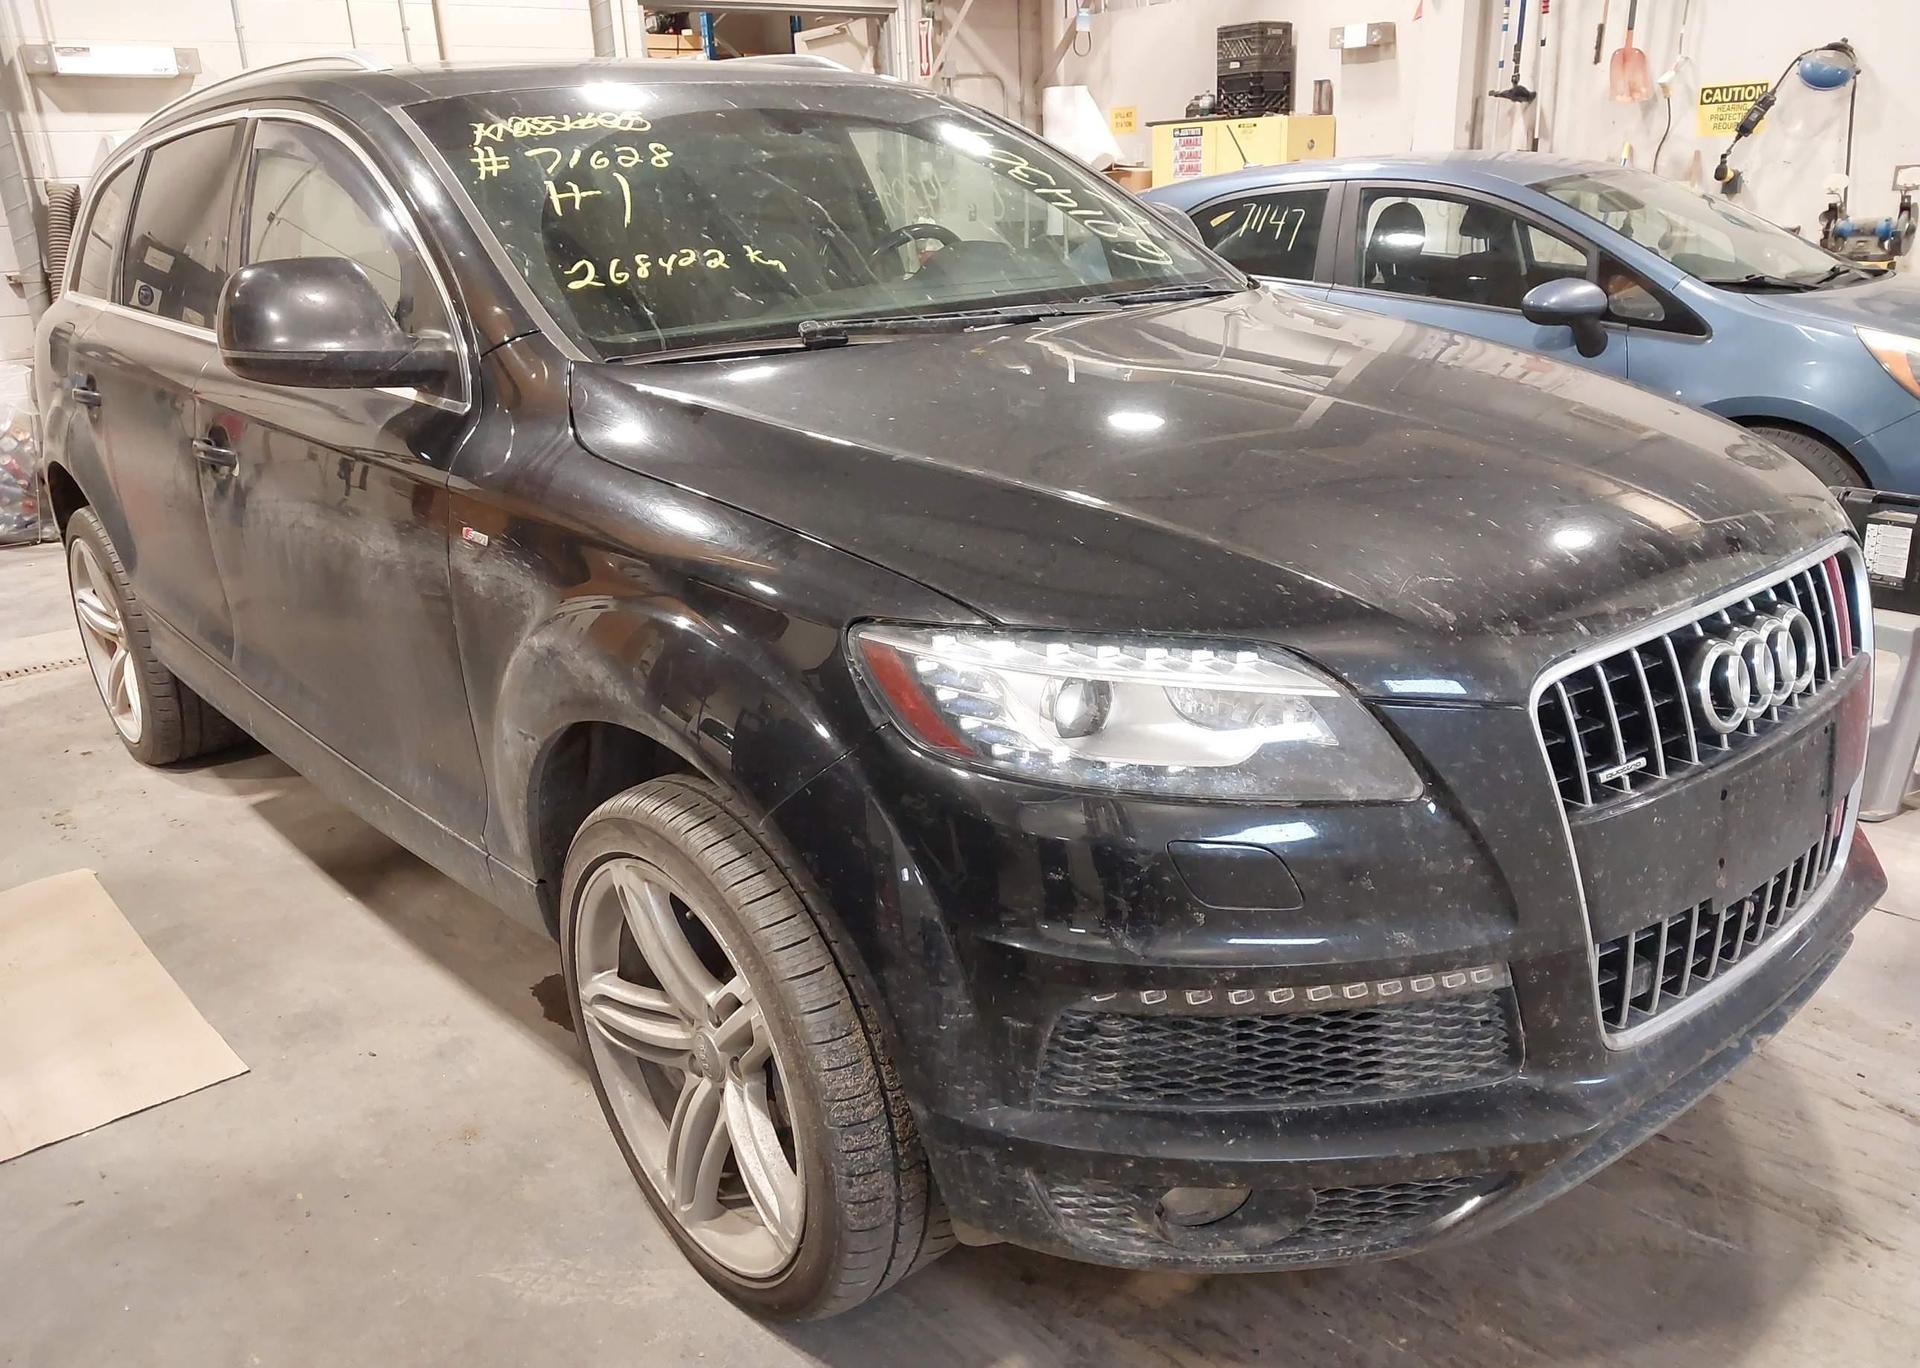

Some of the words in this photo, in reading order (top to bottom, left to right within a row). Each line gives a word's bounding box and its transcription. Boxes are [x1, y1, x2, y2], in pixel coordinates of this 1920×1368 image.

[1702, 85, 1767, 103] CAUTION
[524, 142, 674, 174] 71628
[563, 248, 731, 290] 268422
